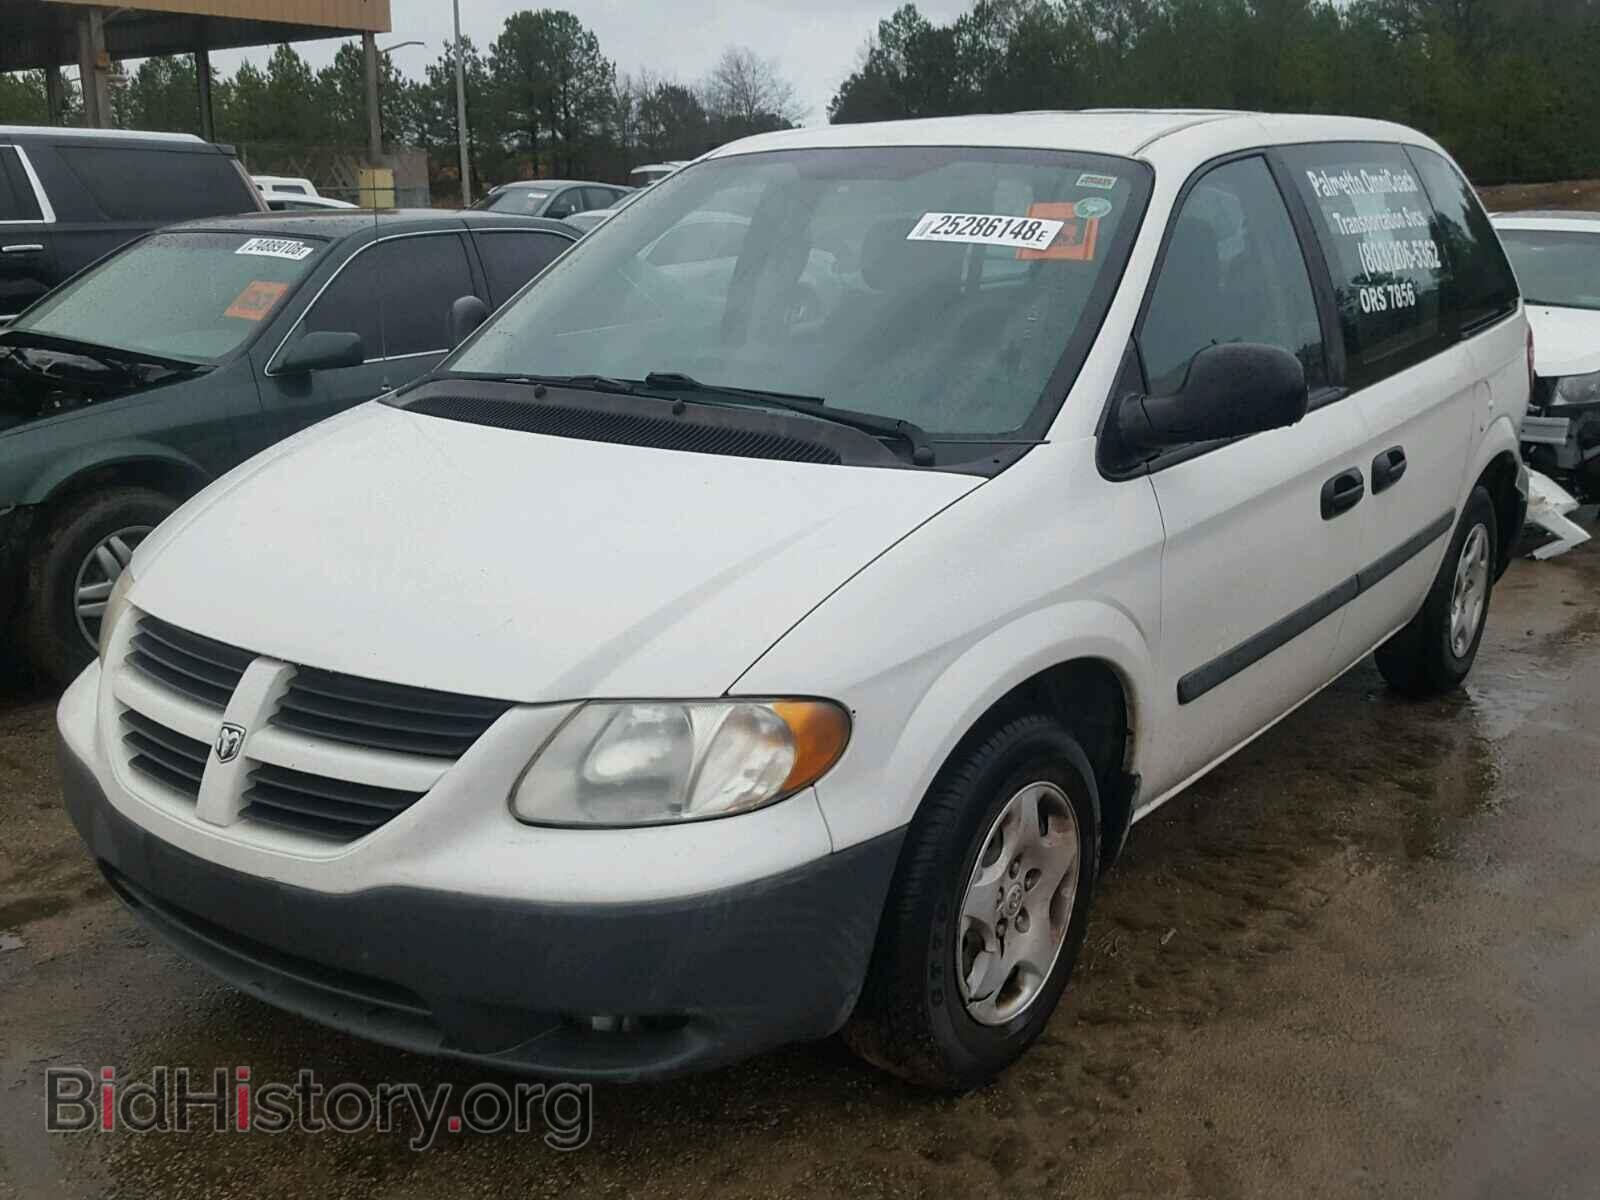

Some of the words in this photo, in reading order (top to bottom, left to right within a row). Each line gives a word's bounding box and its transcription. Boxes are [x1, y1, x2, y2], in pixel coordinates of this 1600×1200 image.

[1306, 169, 1362, 197] Palmetto
[1359, 168, 1418, 193] OmniCoach
[1332, 208, 1405, 238] Transportation
[1359, 286, 1388, 314] ORS
[1387, 282, 1416, 310] 7856
